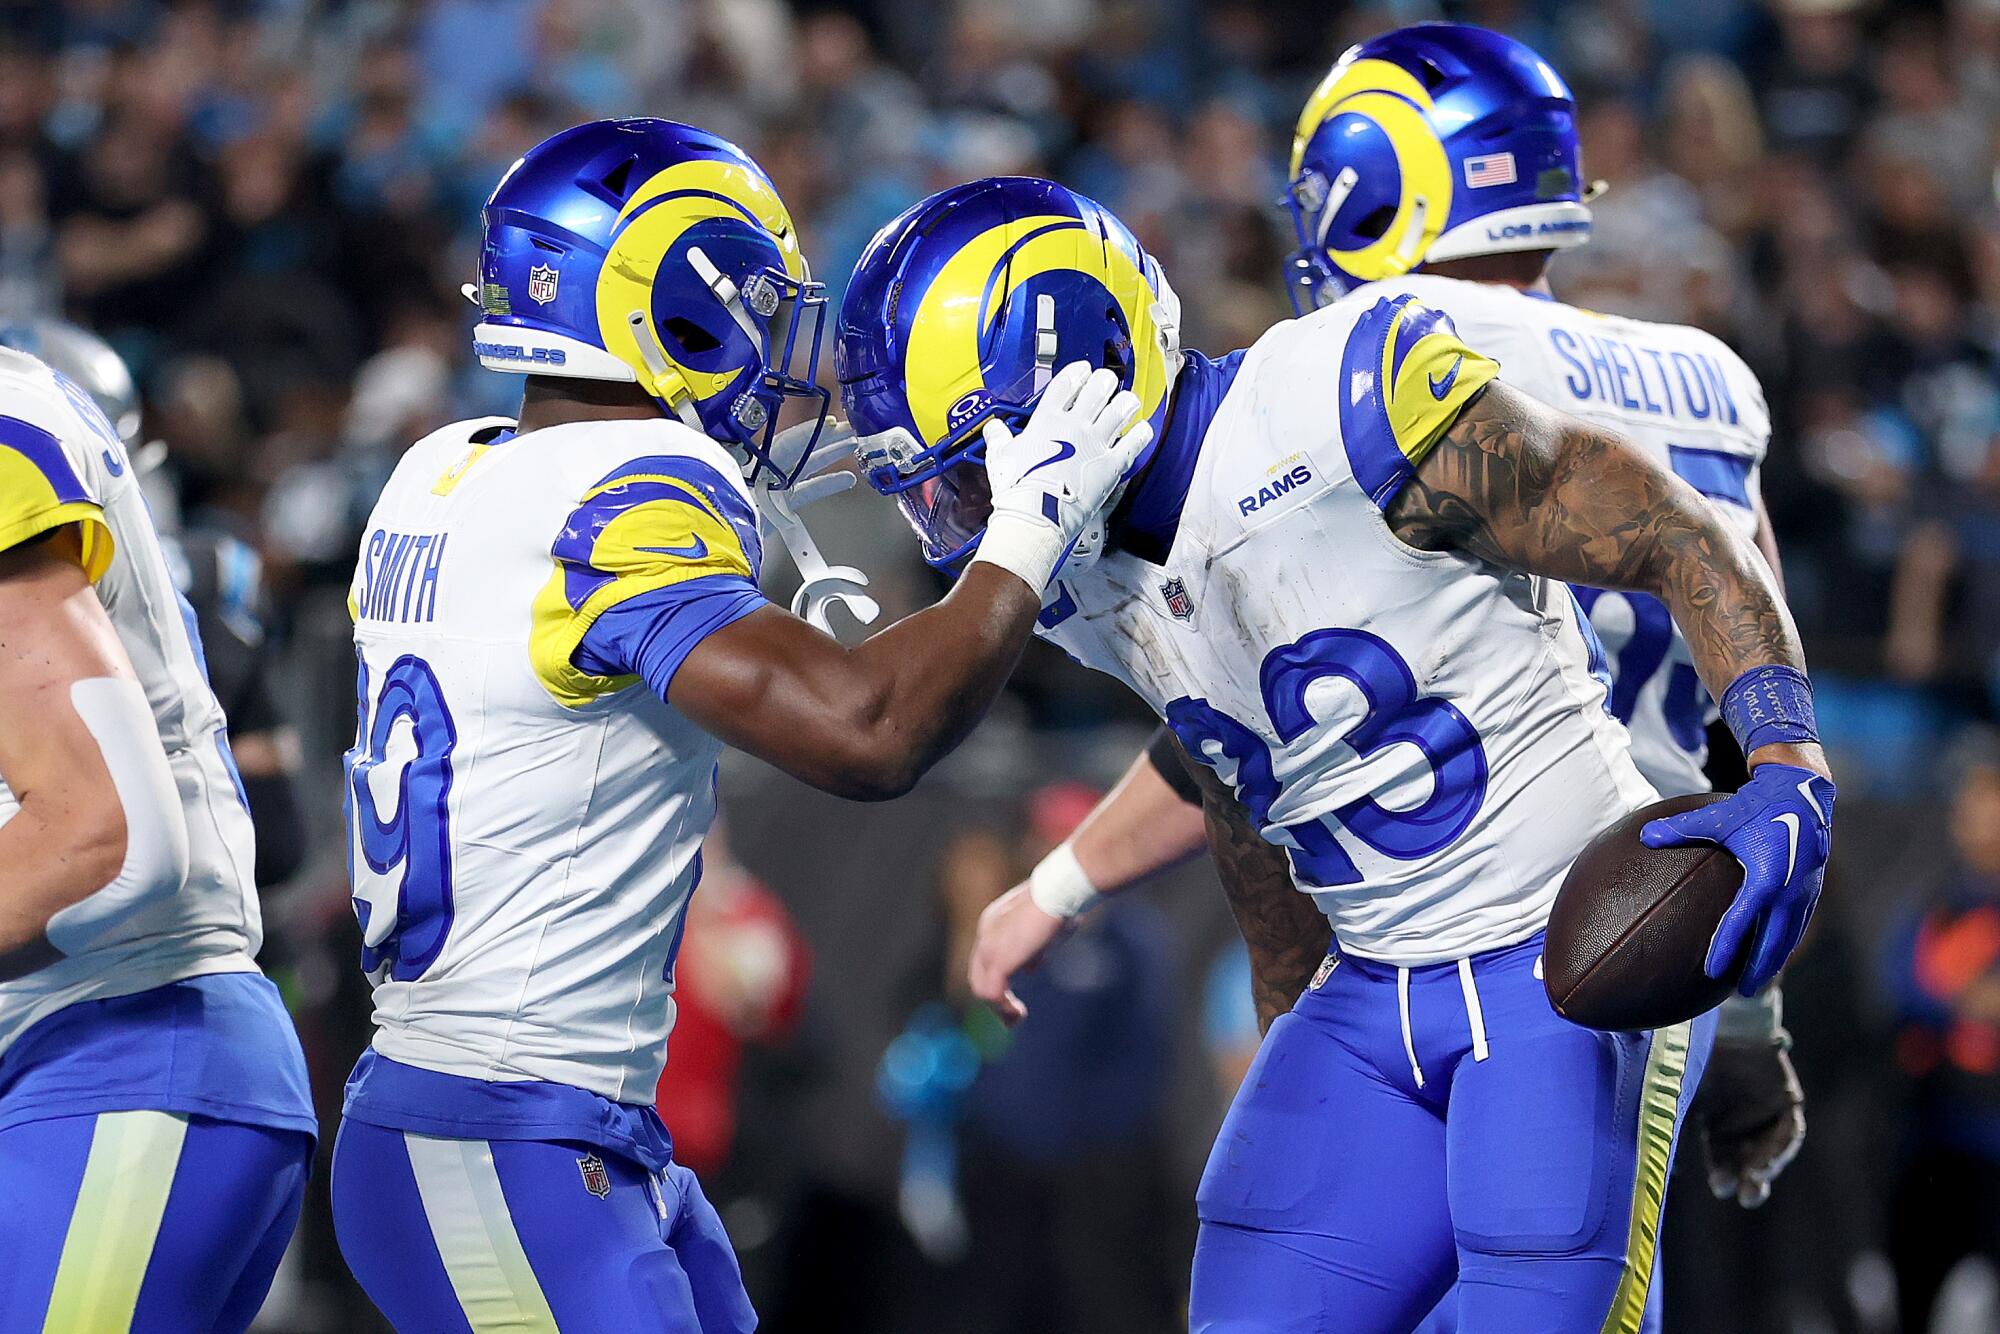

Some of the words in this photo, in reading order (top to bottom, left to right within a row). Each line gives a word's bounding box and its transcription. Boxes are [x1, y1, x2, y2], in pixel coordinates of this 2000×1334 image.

[1487, 224, 1532, 240] LOS
[532, 281, 553, 298] NFL
[1550, 328, 1738, 425] SHELTON
[950, 395, 993, 429] OAKLEY
[1238, 465, 1312, 517] RAMS
[359, 528, 447, 623] SMITH
[1165, 627, 1489, 888] 23
